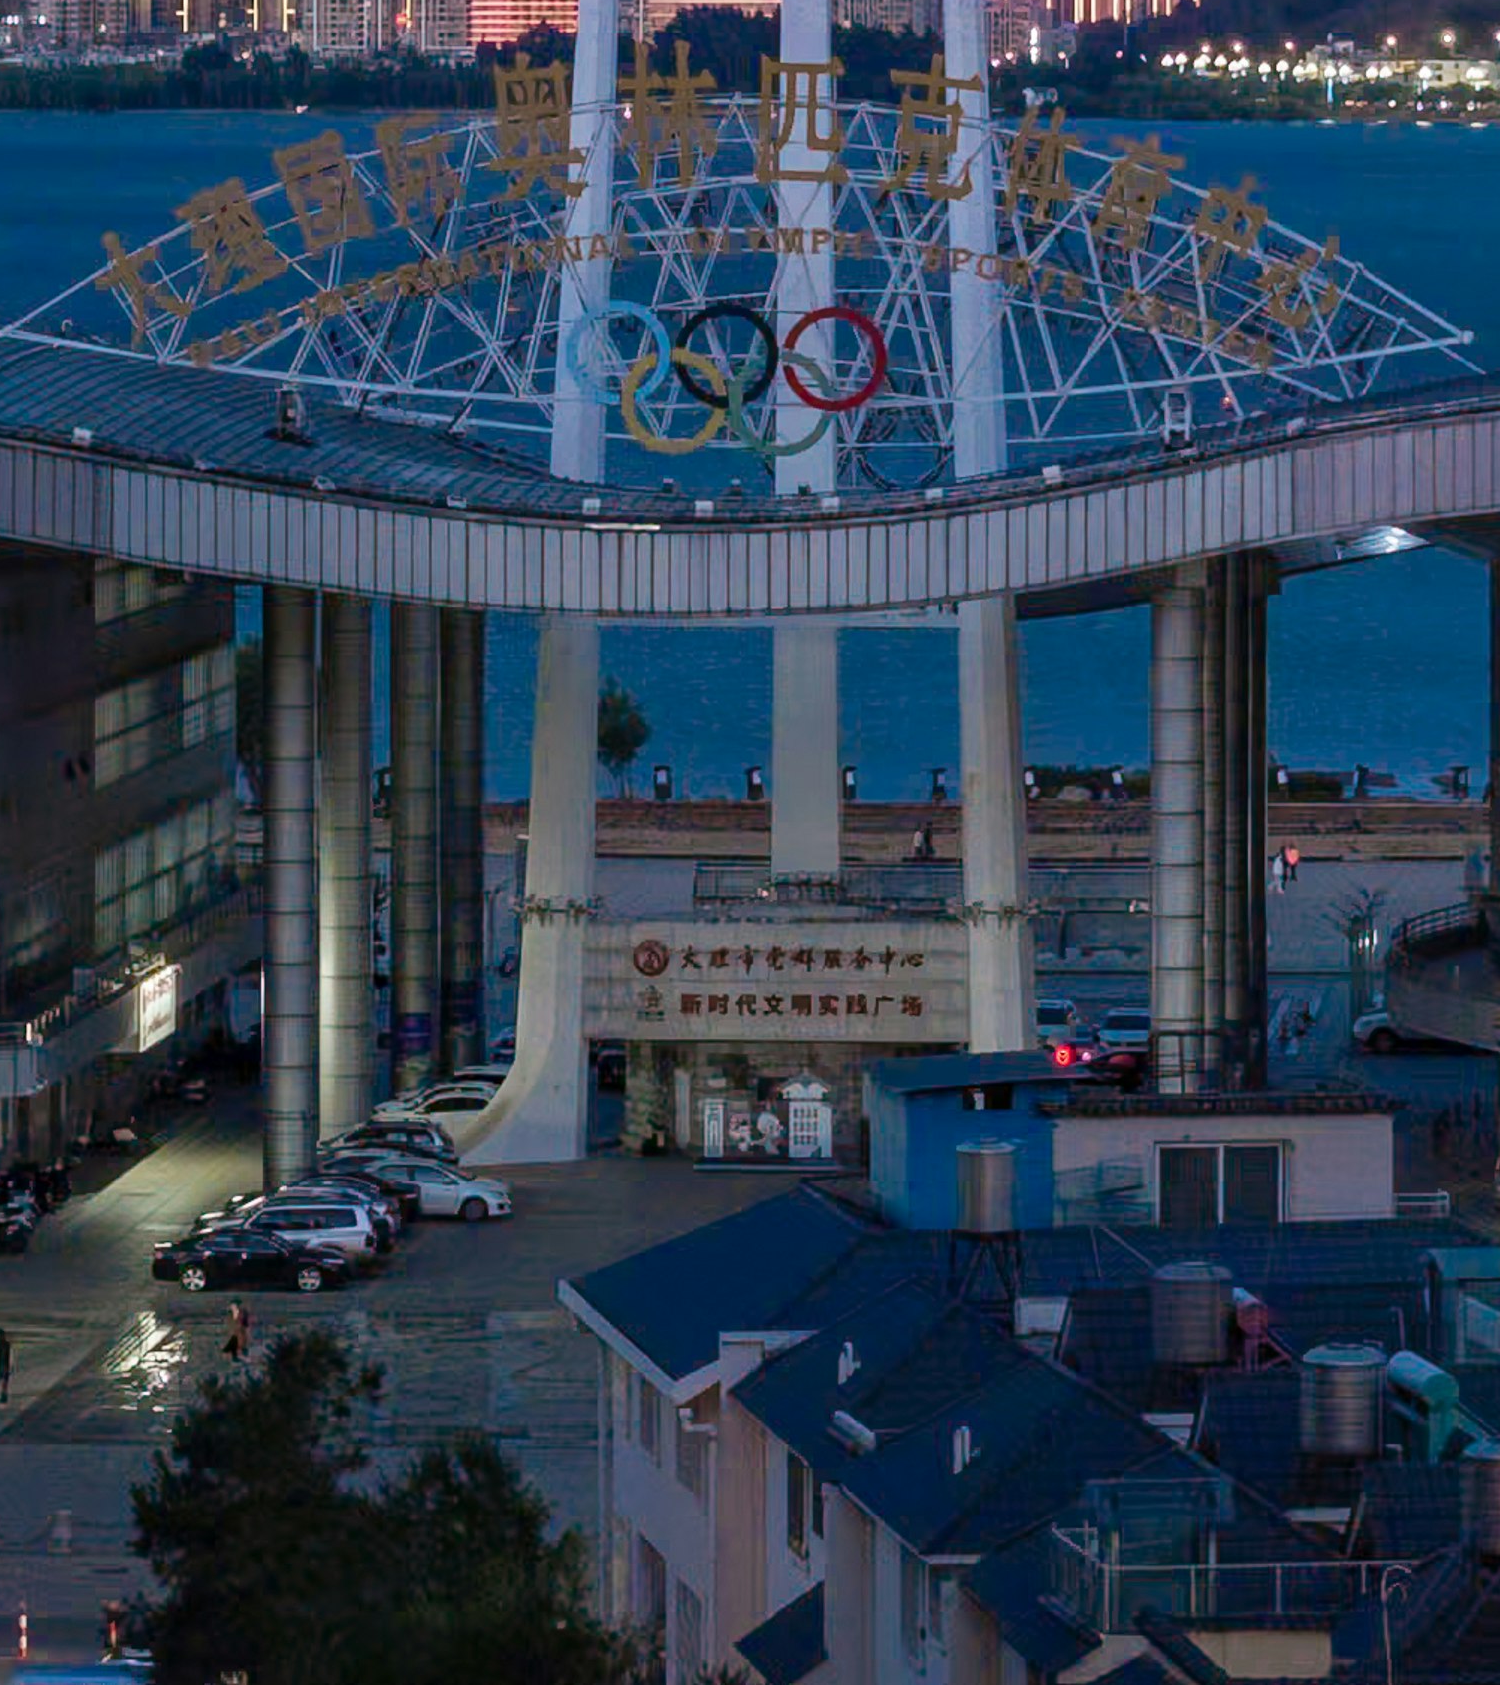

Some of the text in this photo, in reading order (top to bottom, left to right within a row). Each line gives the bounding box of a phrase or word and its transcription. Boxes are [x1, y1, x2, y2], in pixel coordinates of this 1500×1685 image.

[95, 39, 1340, 350] 大理国际奥林匹克体育中心
[680, 993, 924, 1017] 新时代文明实践广场
